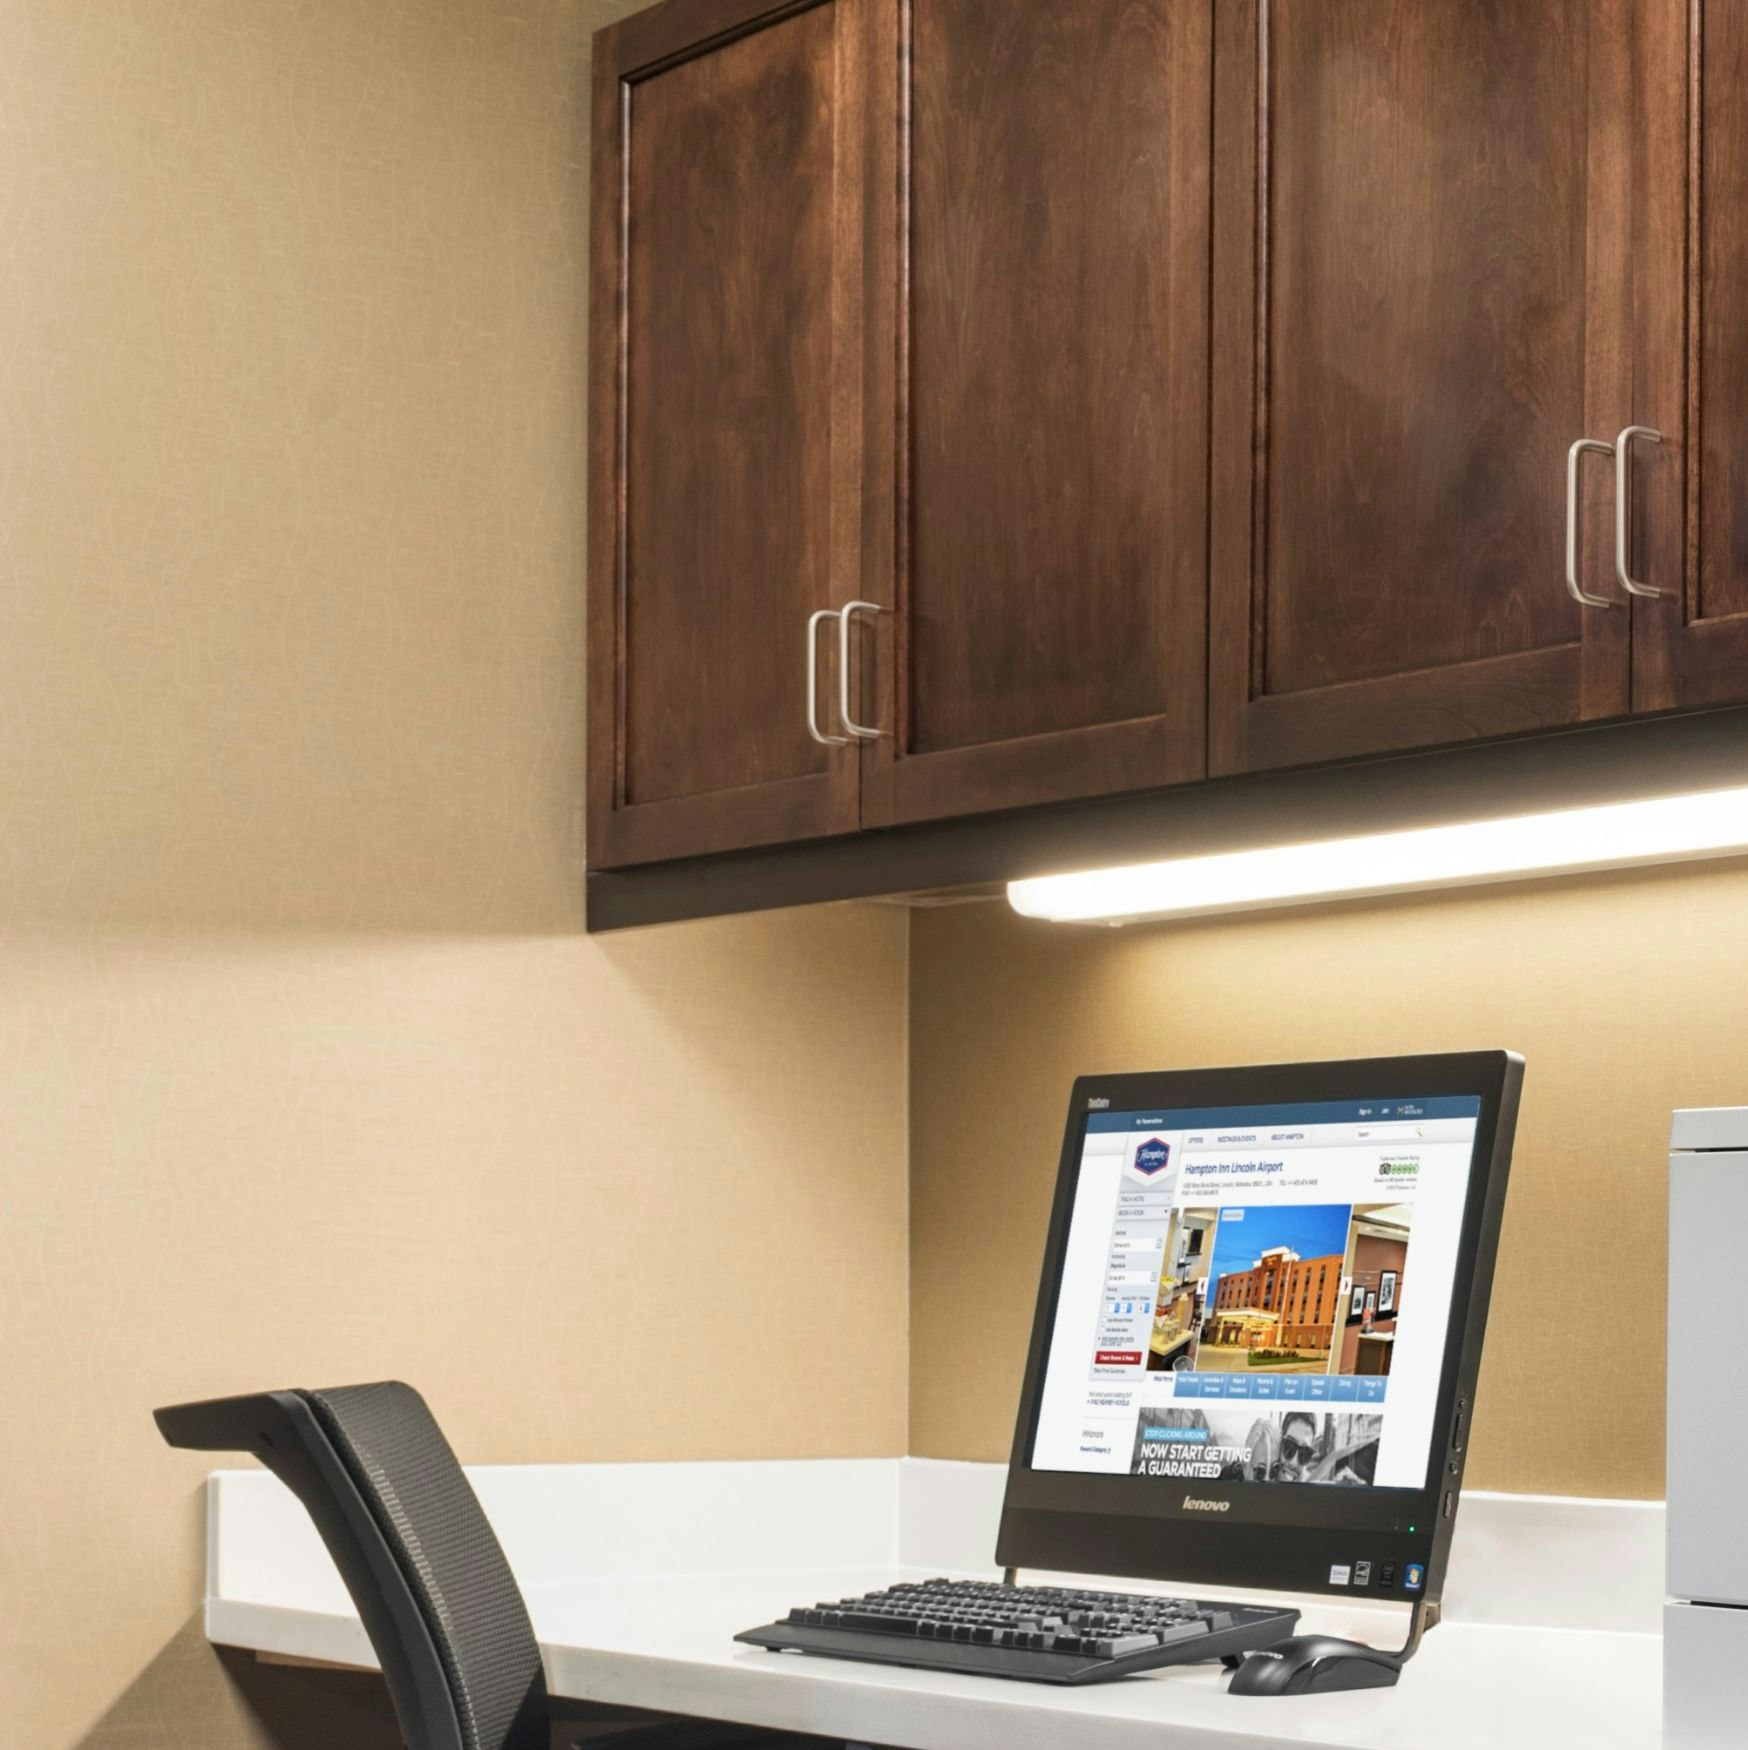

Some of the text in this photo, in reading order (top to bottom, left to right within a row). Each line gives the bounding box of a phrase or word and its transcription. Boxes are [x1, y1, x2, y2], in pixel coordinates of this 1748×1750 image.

[1185, 1161, 1283, 1176] Hampton Inn Lincoln Airport
[1141, 1444, 1252, 1462] NOW START GETTING
[1138, 1462, 1221, 1478] A GUARANTEED
[1182, 1496, 1230, 1512] lenovo
